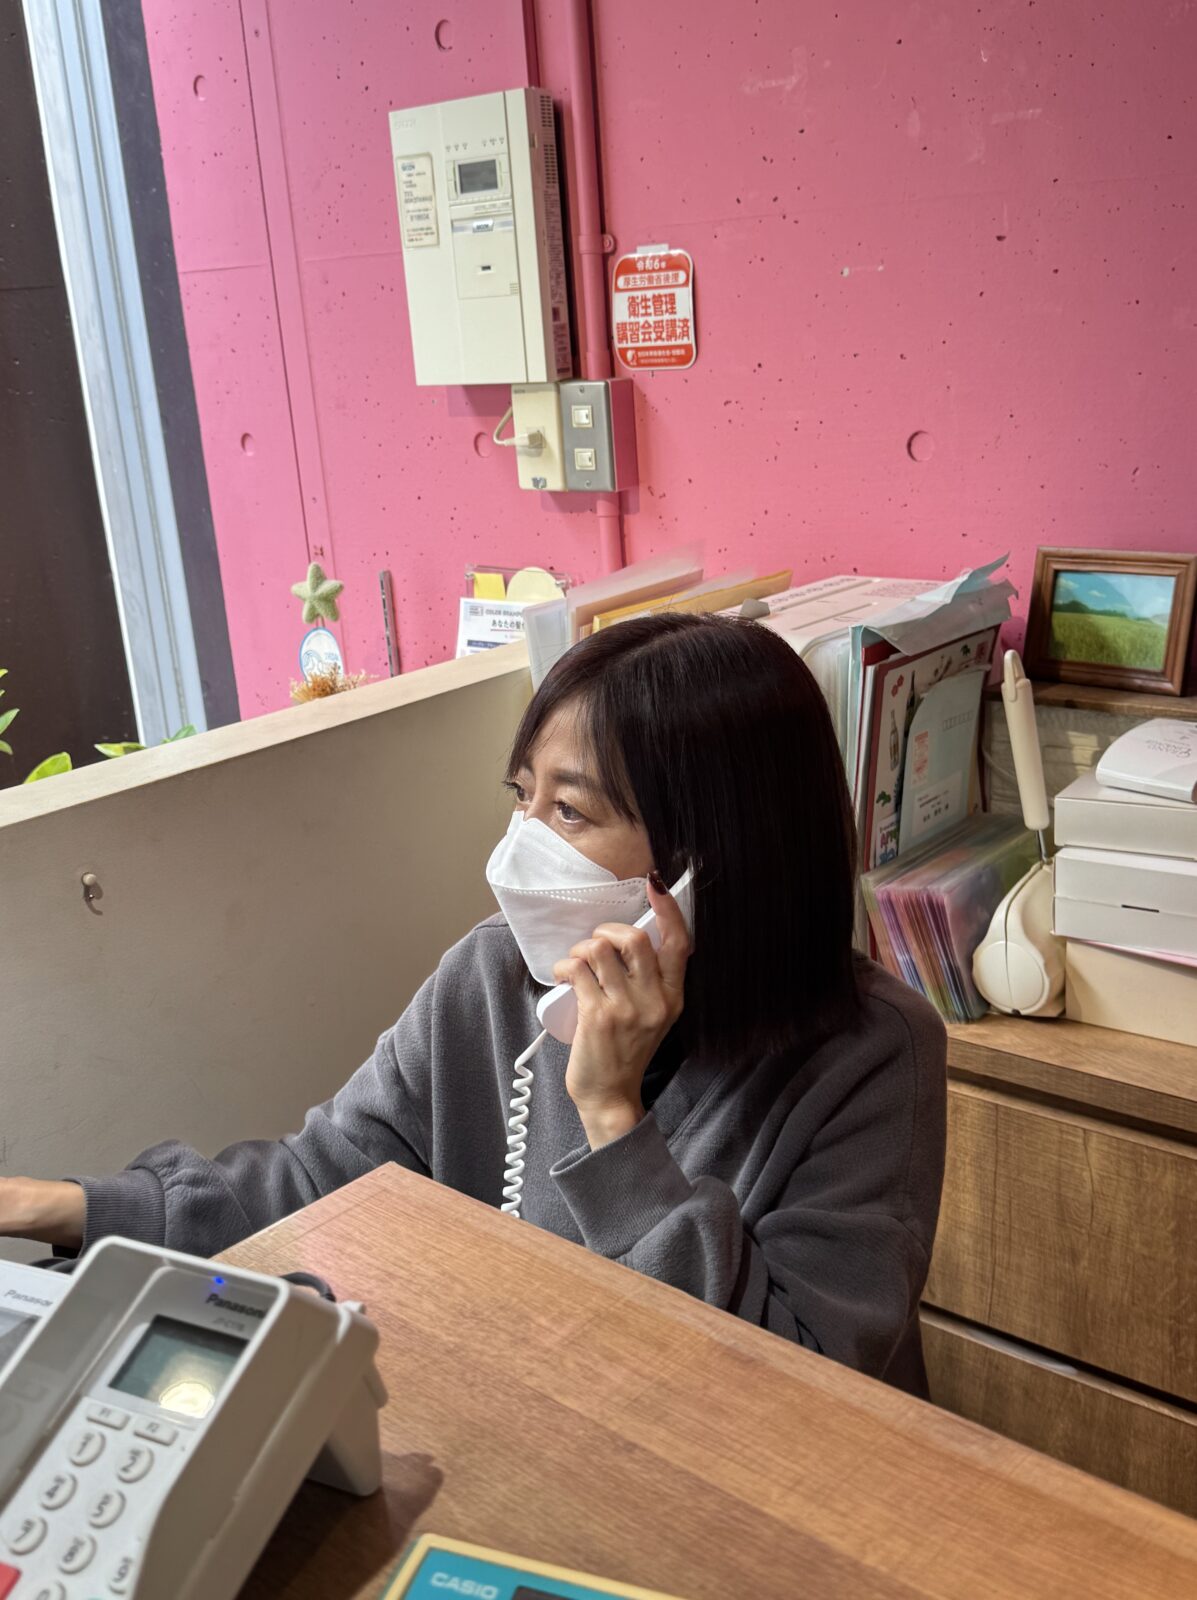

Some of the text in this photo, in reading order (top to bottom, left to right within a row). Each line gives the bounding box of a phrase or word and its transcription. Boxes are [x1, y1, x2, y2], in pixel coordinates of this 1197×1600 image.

[628, 293, 677, 318] 衛生管理
[616, 318, 690, 344] 講習会受講済
[431, 1572, 499, 1600] CASIO
